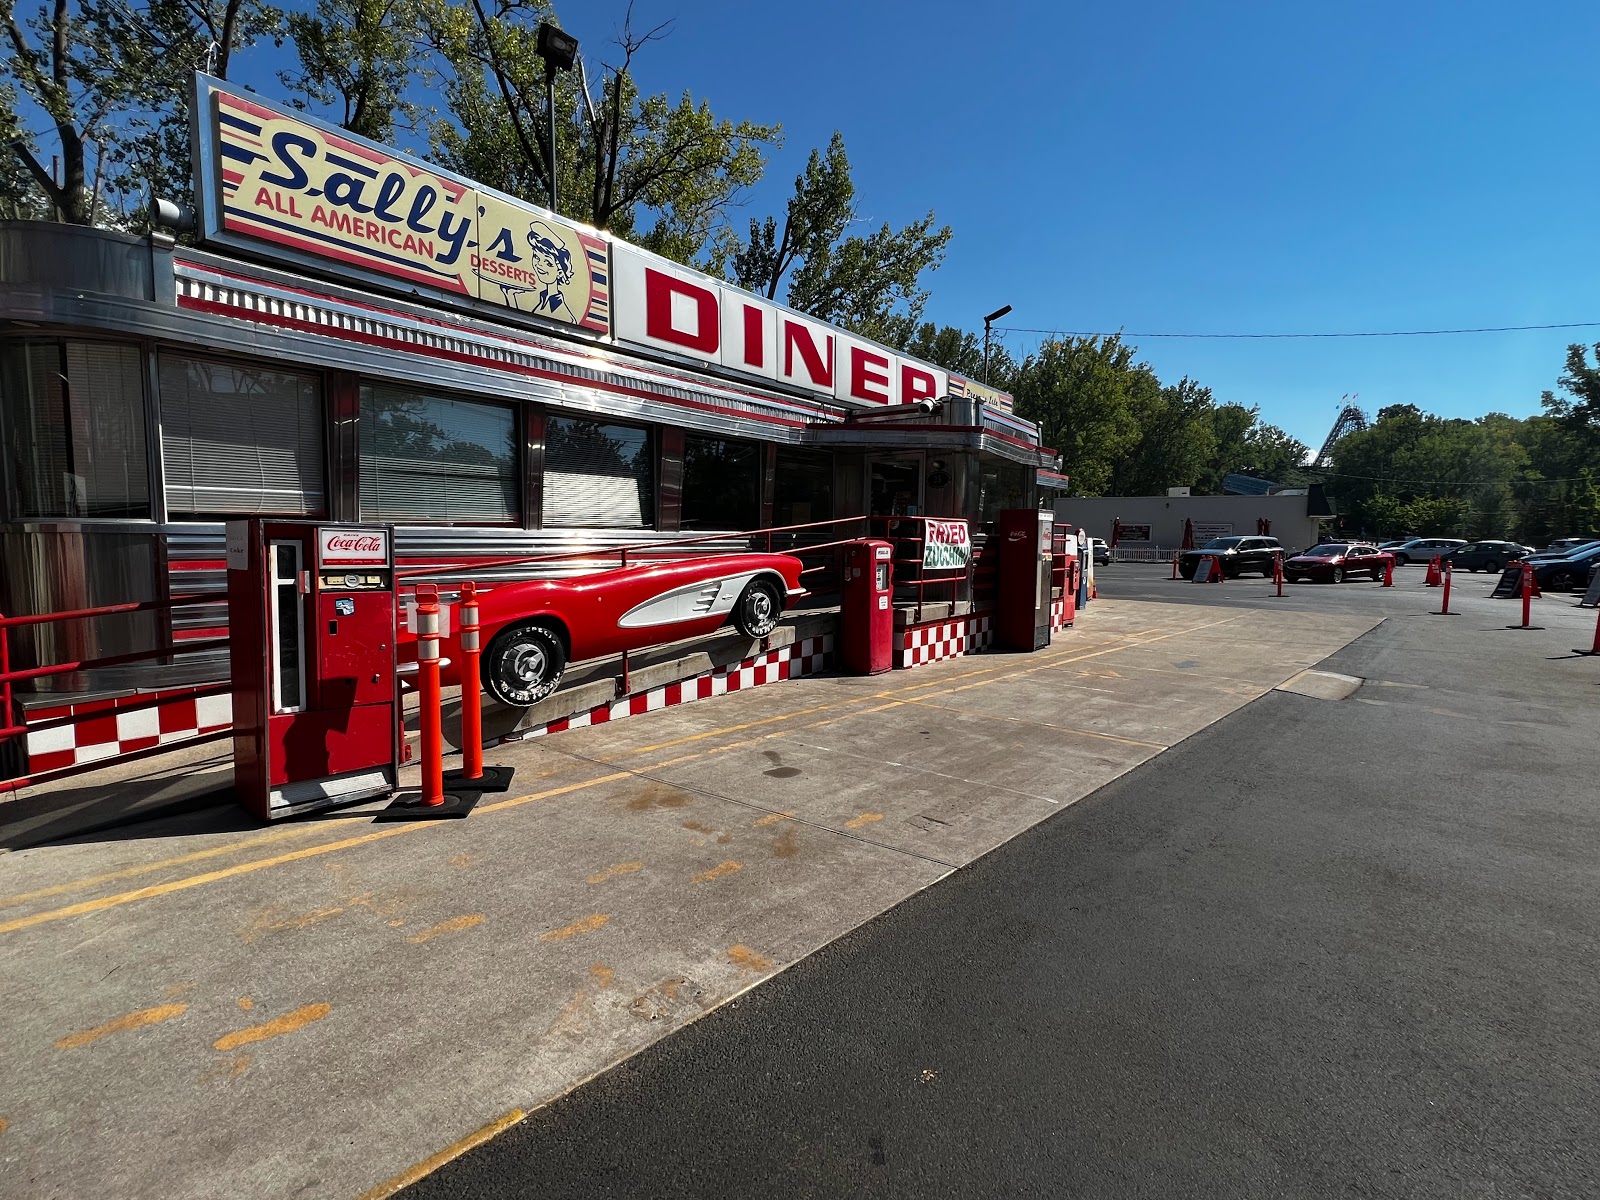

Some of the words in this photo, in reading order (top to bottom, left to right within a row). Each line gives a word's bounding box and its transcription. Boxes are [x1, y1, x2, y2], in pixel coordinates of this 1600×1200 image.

[254, 186, 302, 219] ALL
[311, 204, 433, 259] AMERICAN
[470, 253, 536, 286] DESSERTS
[259, 131, 523, 265] Sally's
[646, 267, 936, 405] DINER
[928, 522, 966, 544] FRIED
